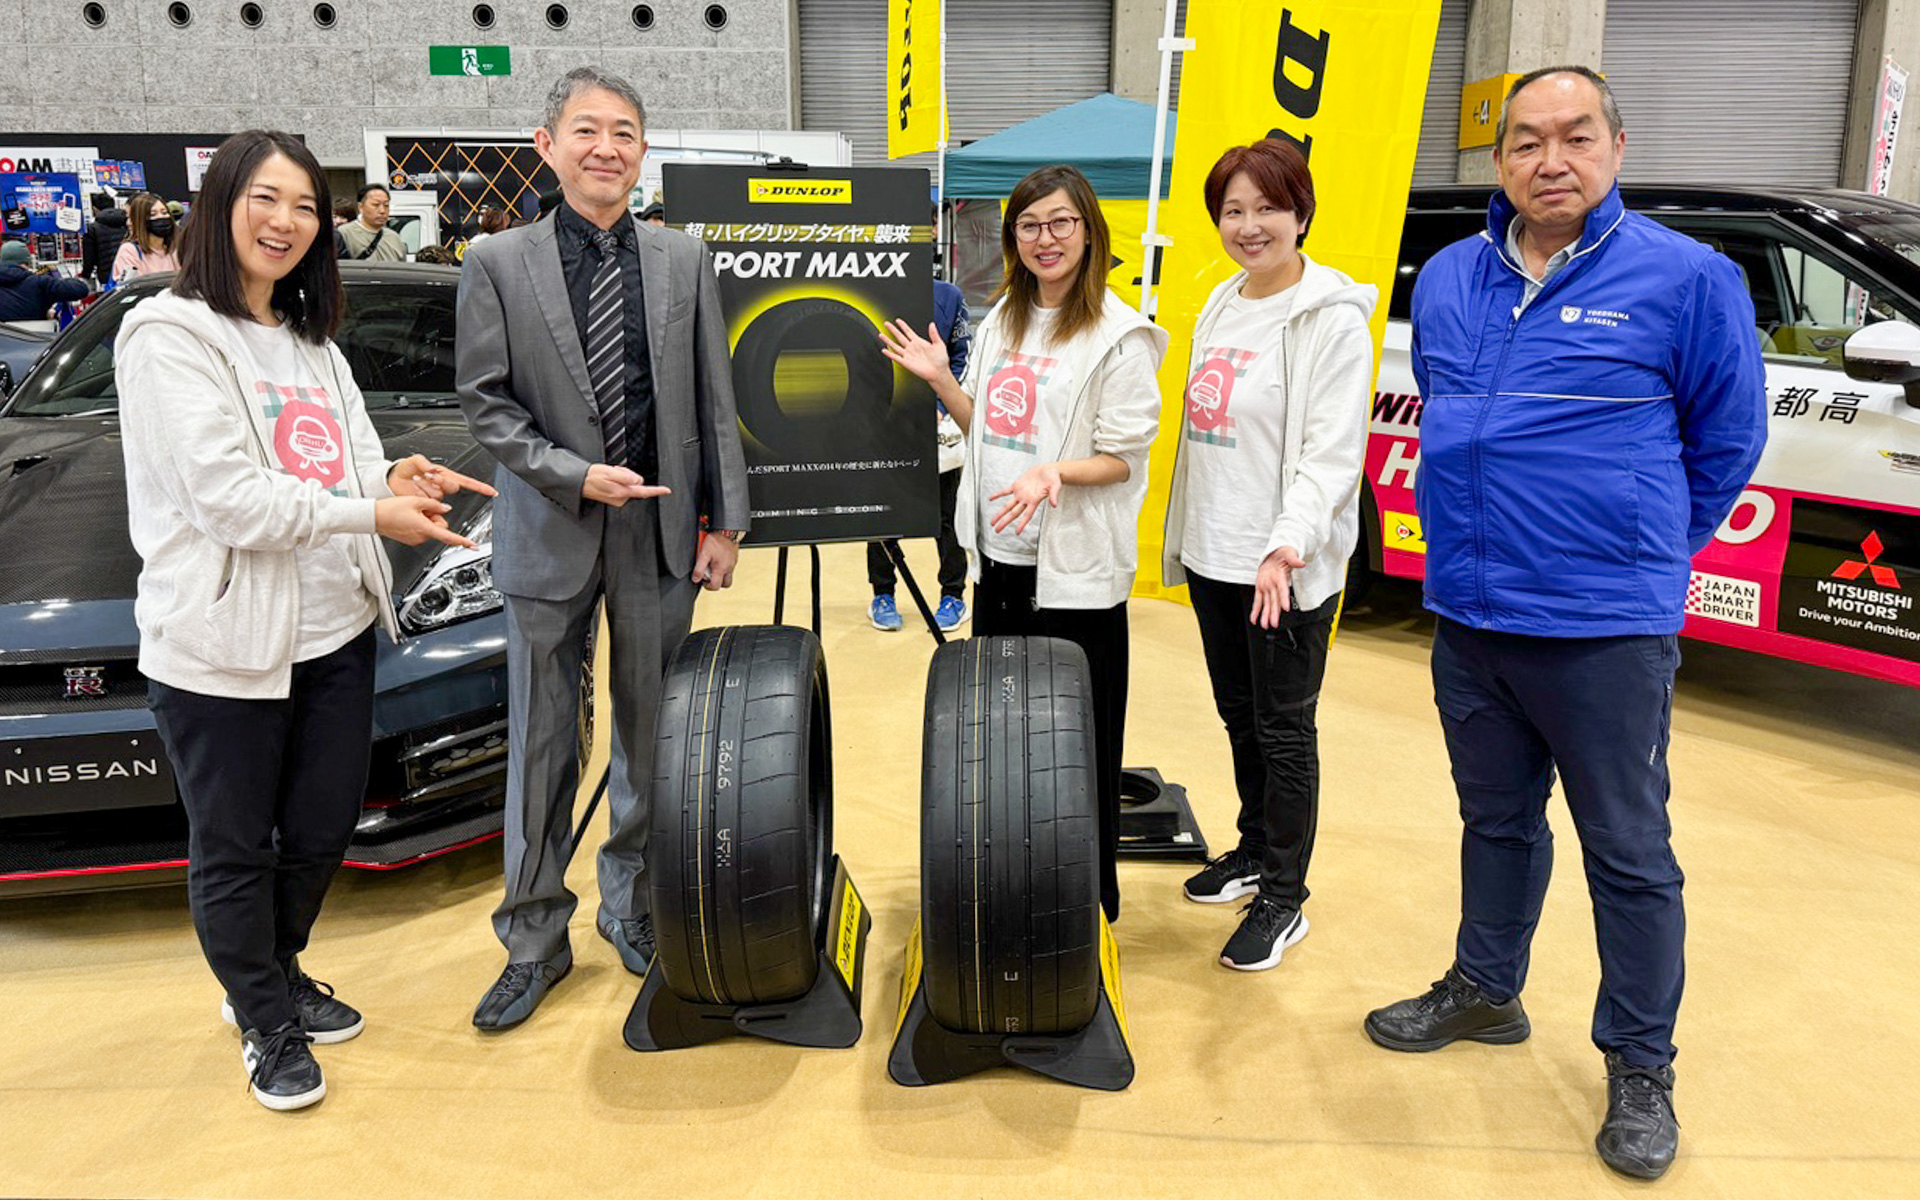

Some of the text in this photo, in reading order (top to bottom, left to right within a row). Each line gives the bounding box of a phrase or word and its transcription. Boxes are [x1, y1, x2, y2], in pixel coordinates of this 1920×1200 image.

[771, 186, 844, 196] DUNLOP
[710, 251, 801, 278] PORT
[804, 251, 911, 278] MAXX
[1703, 591, 1754, 609] SMART
[1704, 579, 1755, 598] JAPAN
[1816, 580, 1913, 609] MITSUBISHI
[1703, 603, 1754, 622] DRIVER
[1799, 607, 1831, 623] Drive
[1833, 614, 1862, 629] your
[1827, 596, 1898, 620] MOTORS
[5, 758, 157, 785] NISSAN
[717, 739, 733, 789] 9792
